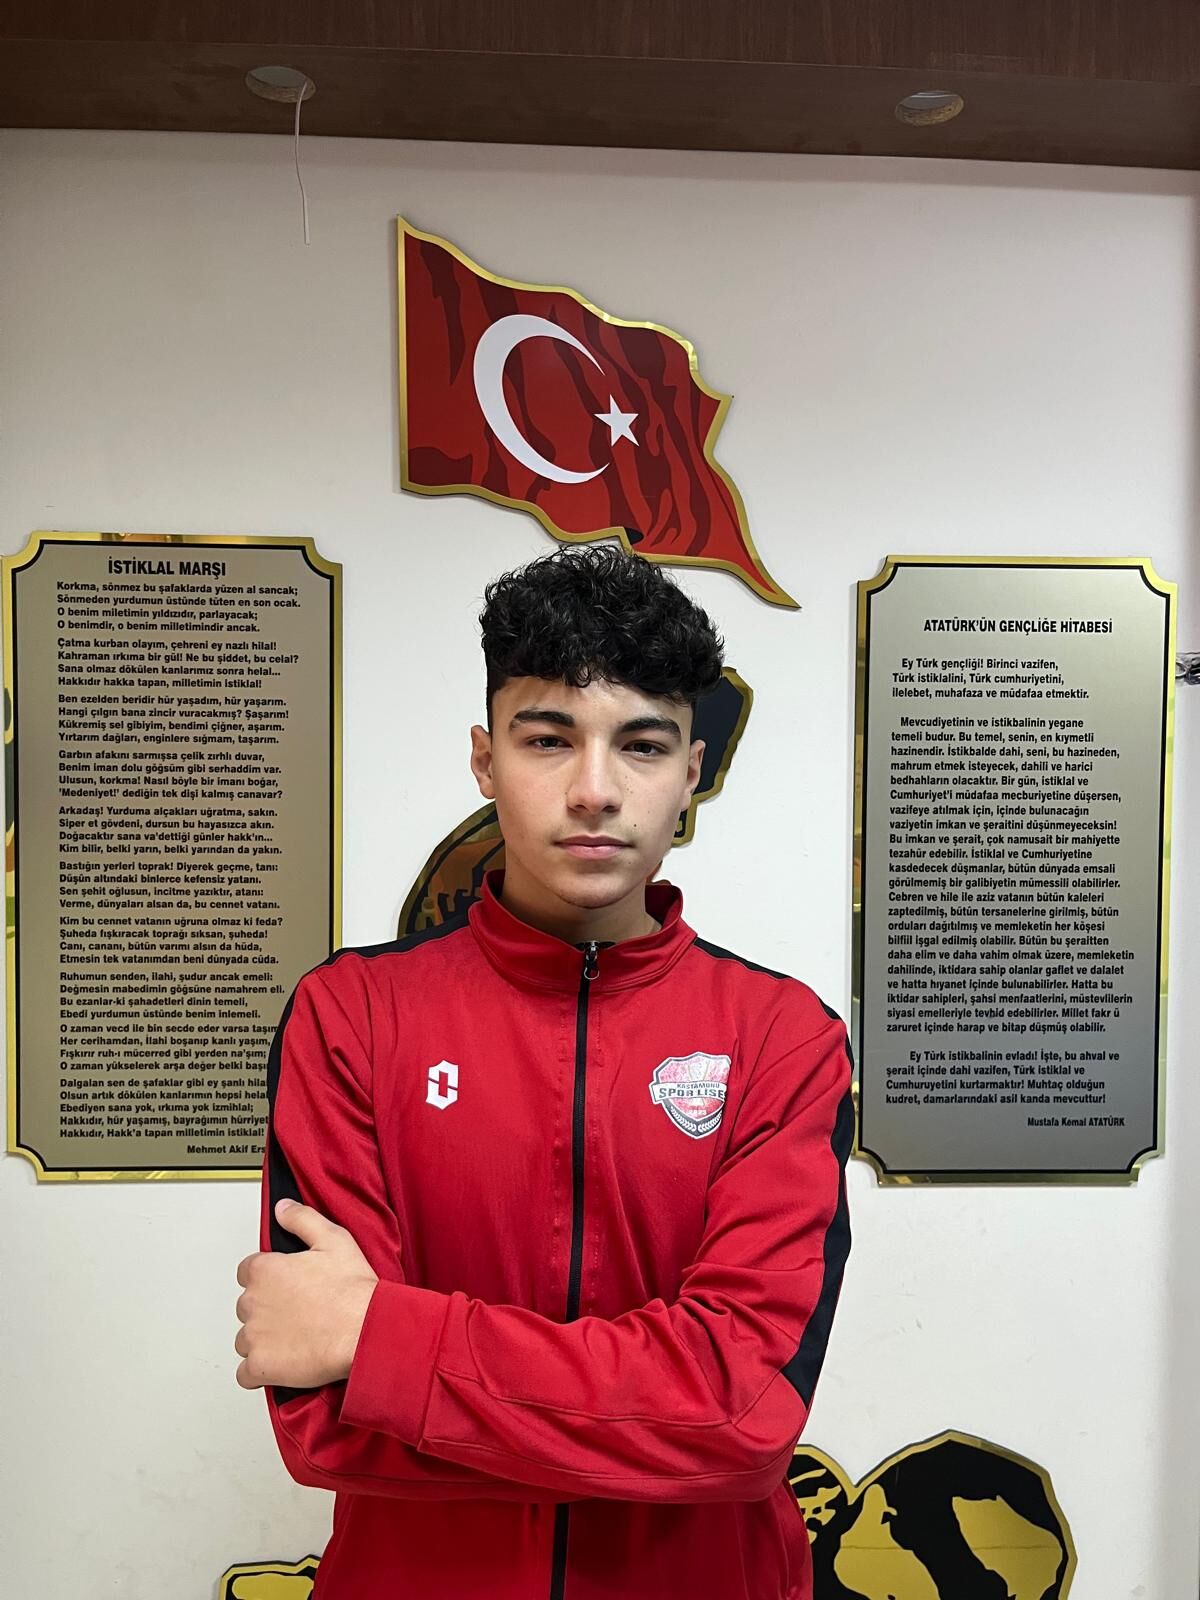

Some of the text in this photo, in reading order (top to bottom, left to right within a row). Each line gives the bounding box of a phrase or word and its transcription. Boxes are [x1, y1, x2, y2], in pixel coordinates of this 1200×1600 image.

[108, 556, 225, 580] İSTİKLAL MARŞI
[56, 581, 99, 592] Korkma,
[143, 583, 156, 591] bu
[246, 585, 256, 593] al
[258, 585, 297, 596] sancak;
[112, 595, 163, 606] yurdumun
[273, 598, 300, 607] ocak.
[57, 620, 65, 628] O
[67, 620, 114, 631] benimdir,
[126, 621, 157, 630] benim
[160, 621, 224, 631] milletimindir
[226, 623, 260, 632] ancak.
[999, 617, 1056, 636] GENÇLİĞE
[1060, 618, 1112, 633] HİTABESİ
[57, 637, 90, 649] Çatma
[93, 638, 129, 647] kurban
[131, 639, 168, 650] olayım,
[210, 642, 222, 651] ey
[225, 641, 248, 649] nazlı
[251, 641, 276, 650] hilal!
[901, 658, 913, 670] Ey
[916, 657, 938, 668] Türk
[986, 658, 1018, 668] Birinci
[1020, 658, 1058, 670] vazifen,
[58, 676, 261, 688] Hakkıdır hakka tapan, milletimin istiklal!
[892, 672, 1064, 686] Türk istiklalini, Türk cumhuriyetini,
[892, 687, 932, 699] ilelebet,
[934, 687, 983, 697] muhafaza
[999, 687, 1042, 698] müdafaa
[1045, 688, 1089, 698] etmektir.
[900, 716, 1083, 730] Mevcudiyetinin ve istikbalinin yegane
[891, 731, 1094, 744] temeli budur. Bu temel, senin, en kıymetli
[58, 749, 92, 758] Garbın
[95, 750, 129, 759] afakını
[207, 751, 231, 760] zırhlı
[234, 752, 264, 762] duvar,
[890, 745, 1119, 758] hazinendir. İstikbalde dahi, seni, bu hazineden,
[58, 775, 96, 785] Ulusun,
[99, 775, 140, 784] korkma!
[143, 776, 168, 785] Nasıl
[200, 776, 214, 785] bir
[217, 776, 245, 785] imanı
[890, 775, 949, 785] bedhahların
[952, 775, 998, 785] olacaktır.
[1001, 775, 1015, 785] Bir
[1041, 775, 1074, 785] istiklal
[58, 818, 85, 829] Siper
[87, 819, 98, 827] et
[145, 819, 179, 828] dursun
[182, 819, 195, 828] bu
[197, 820, 247, 830] hayasızca
[249, 820, 274, 828] akın.
[889, 819, 933, 831] vaziyetin
[935, 819, 966, 829] imkan
[968, 821, 980, 829] ve
[982, 819, 1023, 832] şeraitini
[888, 862, 948, 872] kasdedecek
[1008, 863, 1036, 872] bütün
[1038, 863, 1080, 875] dünyada
[1082, 863, 1115, 873] emsali
[59, 899, 94, 909] Verme,
[146, 899, 173, 908] alsan
[176, 899, 191, 909] da,
[194, 900, 207, 908] bu
[209, 900, 243, 908] cennet
[246, 900, 280, 908] vatanı.
[950, 906, 978, 916] bütün
[981, 906, 1046, 916] tersanelerine
[1090, 906, 1118, 916] bütün
[887, 920, 926, 930] orduları
[928, 920, 978, 933] dağıtılmış
[994, 920, 1052, 930] memleketin
[1054, 921, 1071, 930] her
[1073, 920, 1104, 933] köşesi
[59, 954, 100, 963] Etmesin
[102, 954, 119, 963] tek
[121, 954, 180, 963] vatanımdan
[183, 954, 204, 963] beni
[60, 1009, 87, 1018] Ebedi
[90, 1009, 140, 1020] yurdumun
[185, 1009, 215, 1018] benim
[218, 1009, 260, 1018] inlemeli.
[659, 1087, 694, 1098] SPOR
[885, 1093, 1105, 1104] kudret, damarlarındaki asil kanda mevcuttur!
[60, 1103, 105, 1114] Ebediyen
[134, 1102, 155, 1113] yok,
[157, 1103, 189, 1111] ırkıma
[192, 1103, 209, 1113] yok
[212, 1102, 253, 1112] izmihlal;
[1027, 1116, 1124, 1126] Mustafa Kemal ATATÜRK
[186, 1144, 226, 1153] Mehmet
[228, 1144, 248, 1153] Akif
